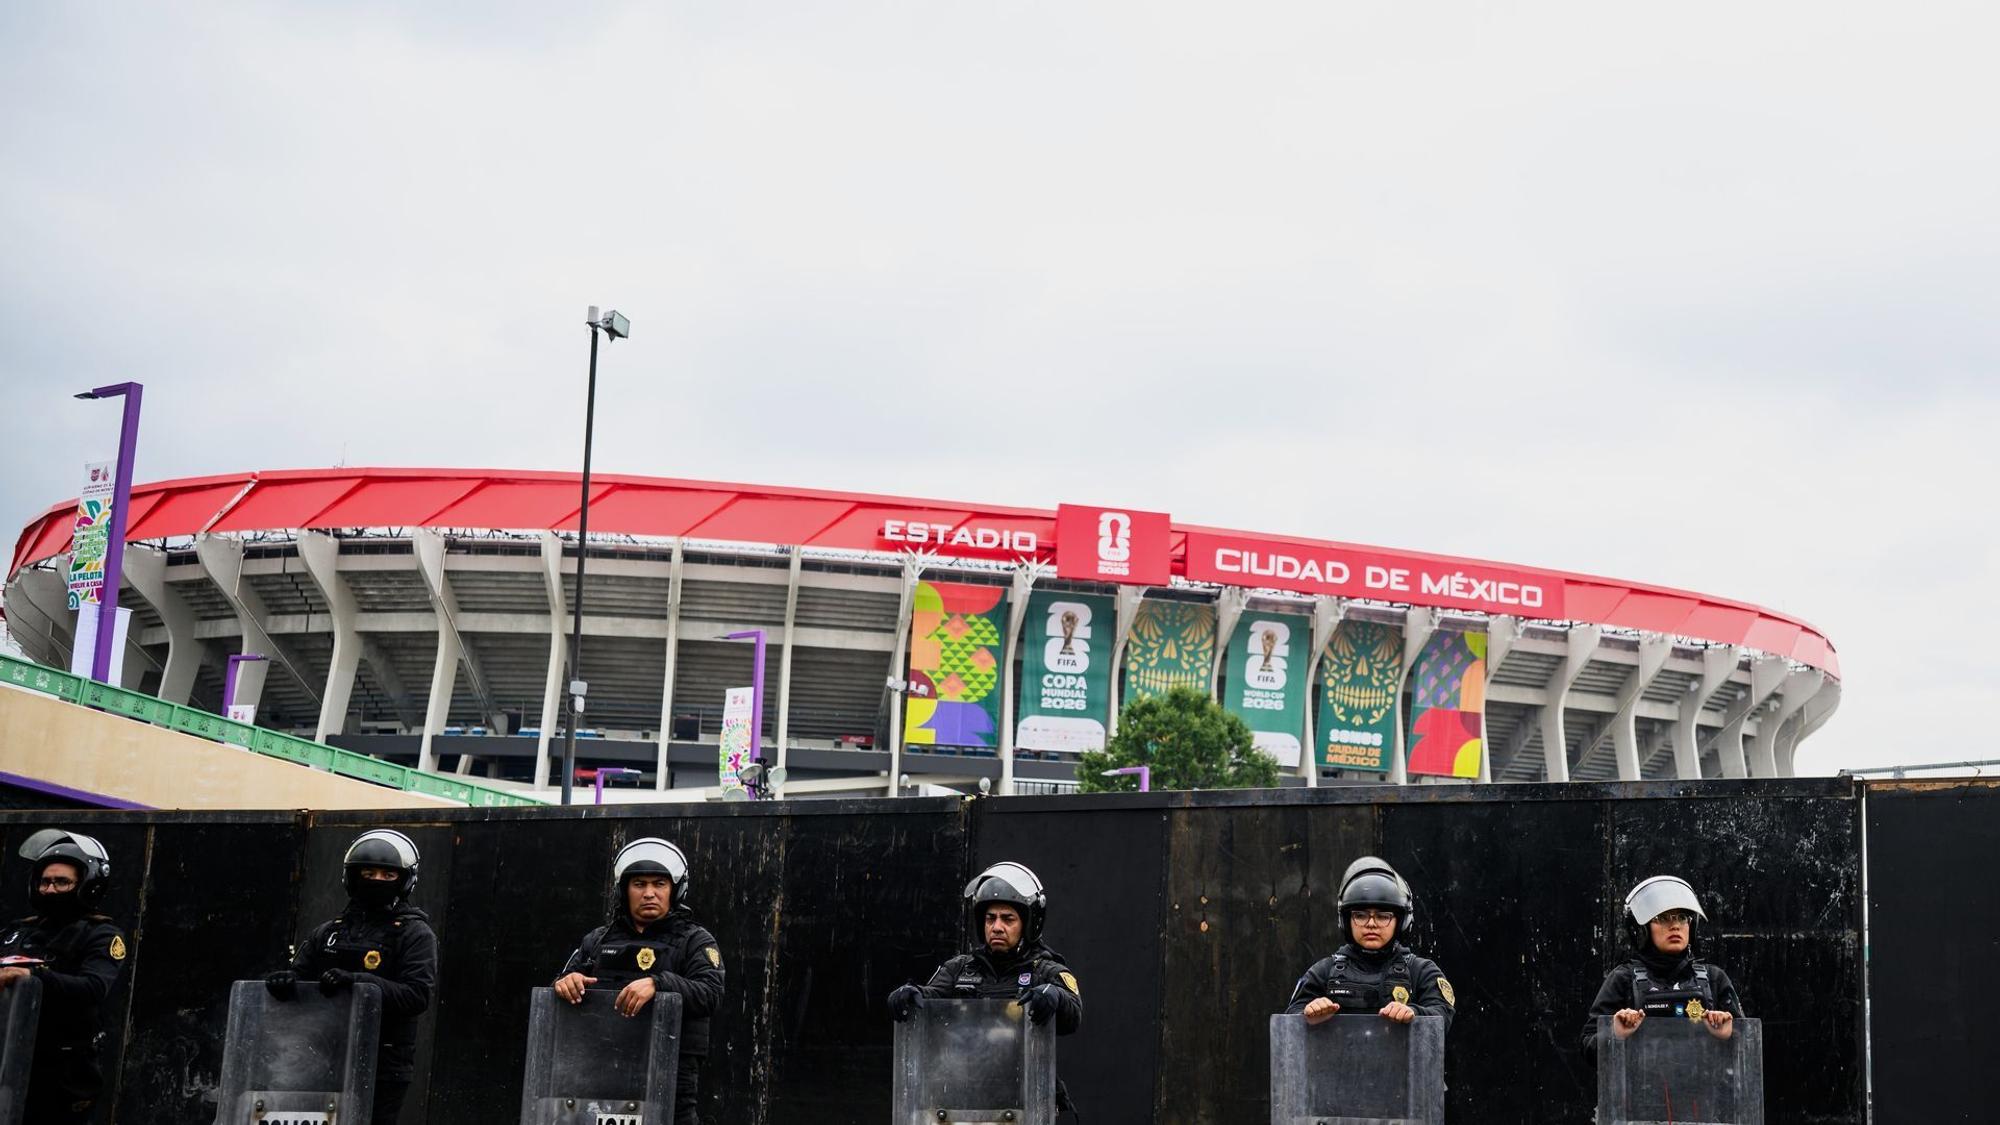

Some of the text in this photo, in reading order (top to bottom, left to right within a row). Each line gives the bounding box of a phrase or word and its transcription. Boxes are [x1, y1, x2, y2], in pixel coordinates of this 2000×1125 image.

[884, 520, 1037, 552] ESTADIO
[69, 571, 103, 582] LA PELOTA
[1215, 548, 1543, 608] CIUDAD DE MÉXICO
[90, 580, 103, 588] CASA
[1057, 658, 1078, 667] FIFA
[1042, 674, 1087, 690] COPA
[1257, 675, 1276, 684] FIFA
[1041, 688, 1087, 698] MUNDIAL
[1243, 689, 1285, 700] WORLD CUP
[1041, 697, 1087, 710] 2026
[1242, 698, 1285, 711] 2026
[1328, 743, 1381, 757] CIUDAD DE
